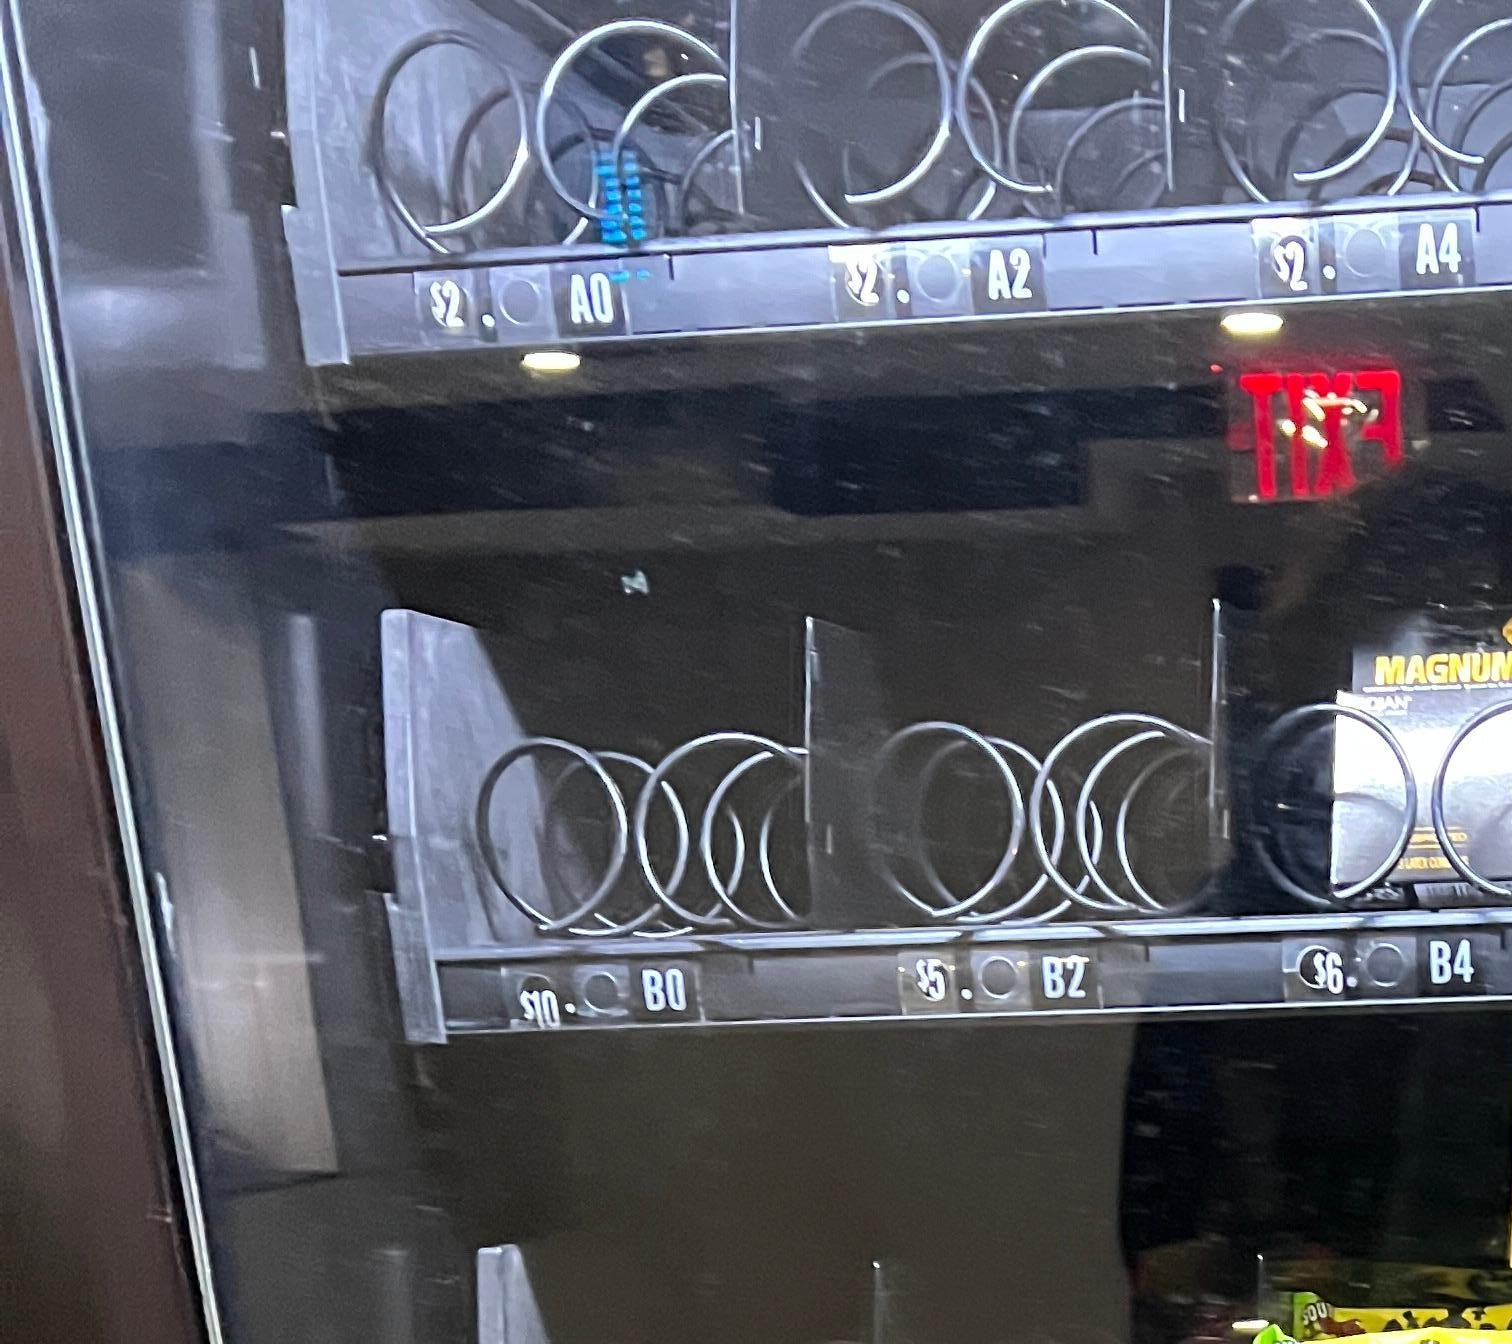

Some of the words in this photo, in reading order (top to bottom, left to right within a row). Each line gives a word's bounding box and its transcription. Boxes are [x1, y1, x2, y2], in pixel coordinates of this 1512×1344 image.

[1416, 222, 1463, 275] A4
[570, 272, 613, 325] A0
[987, 248, 1032, 300] A2
[1042, 955, 1087, 999] B2
[1428, 938, 1475, 985] B4
[641, 968, 687, 1012] B0
